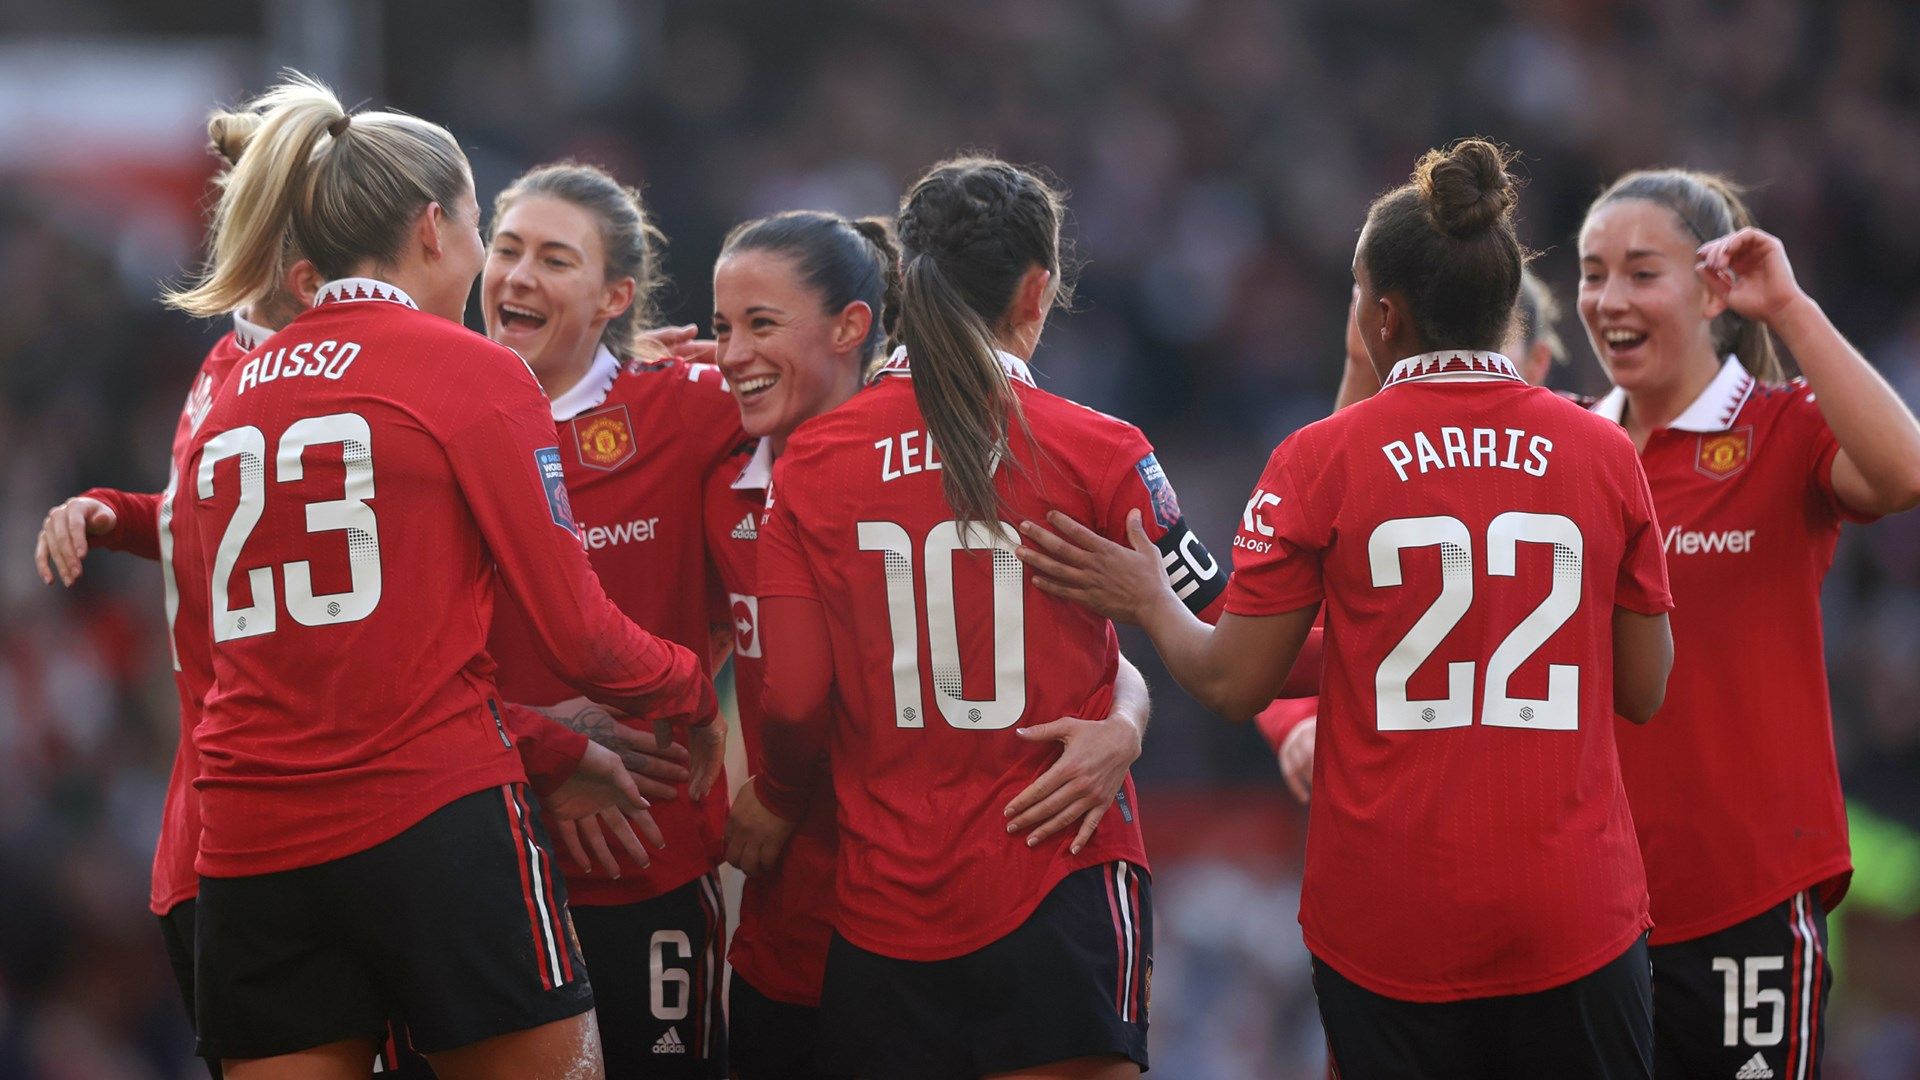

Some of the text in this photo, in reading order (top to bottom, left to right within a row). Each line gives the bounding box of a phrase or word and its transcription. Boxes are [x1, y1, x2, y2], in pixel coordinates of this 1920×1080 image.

[237, 340, 361, 396] RUSSO
[1382, 427, 1553, 482] PARRIS
[197, 412, 382, 643] 23
[578, 517, 659, 550] iewer
[731, 527, 758, 540] adidas
[857, 520, 1026, 730] 10
[1368, 511, 1584, 731] 22
[650, 930, 692, 1020] 6
[1712, 956, 1785, 1047] 15
[652, 1042, 686, 1054] adidas
[1735, 1067, 1774, 1080] adidas
